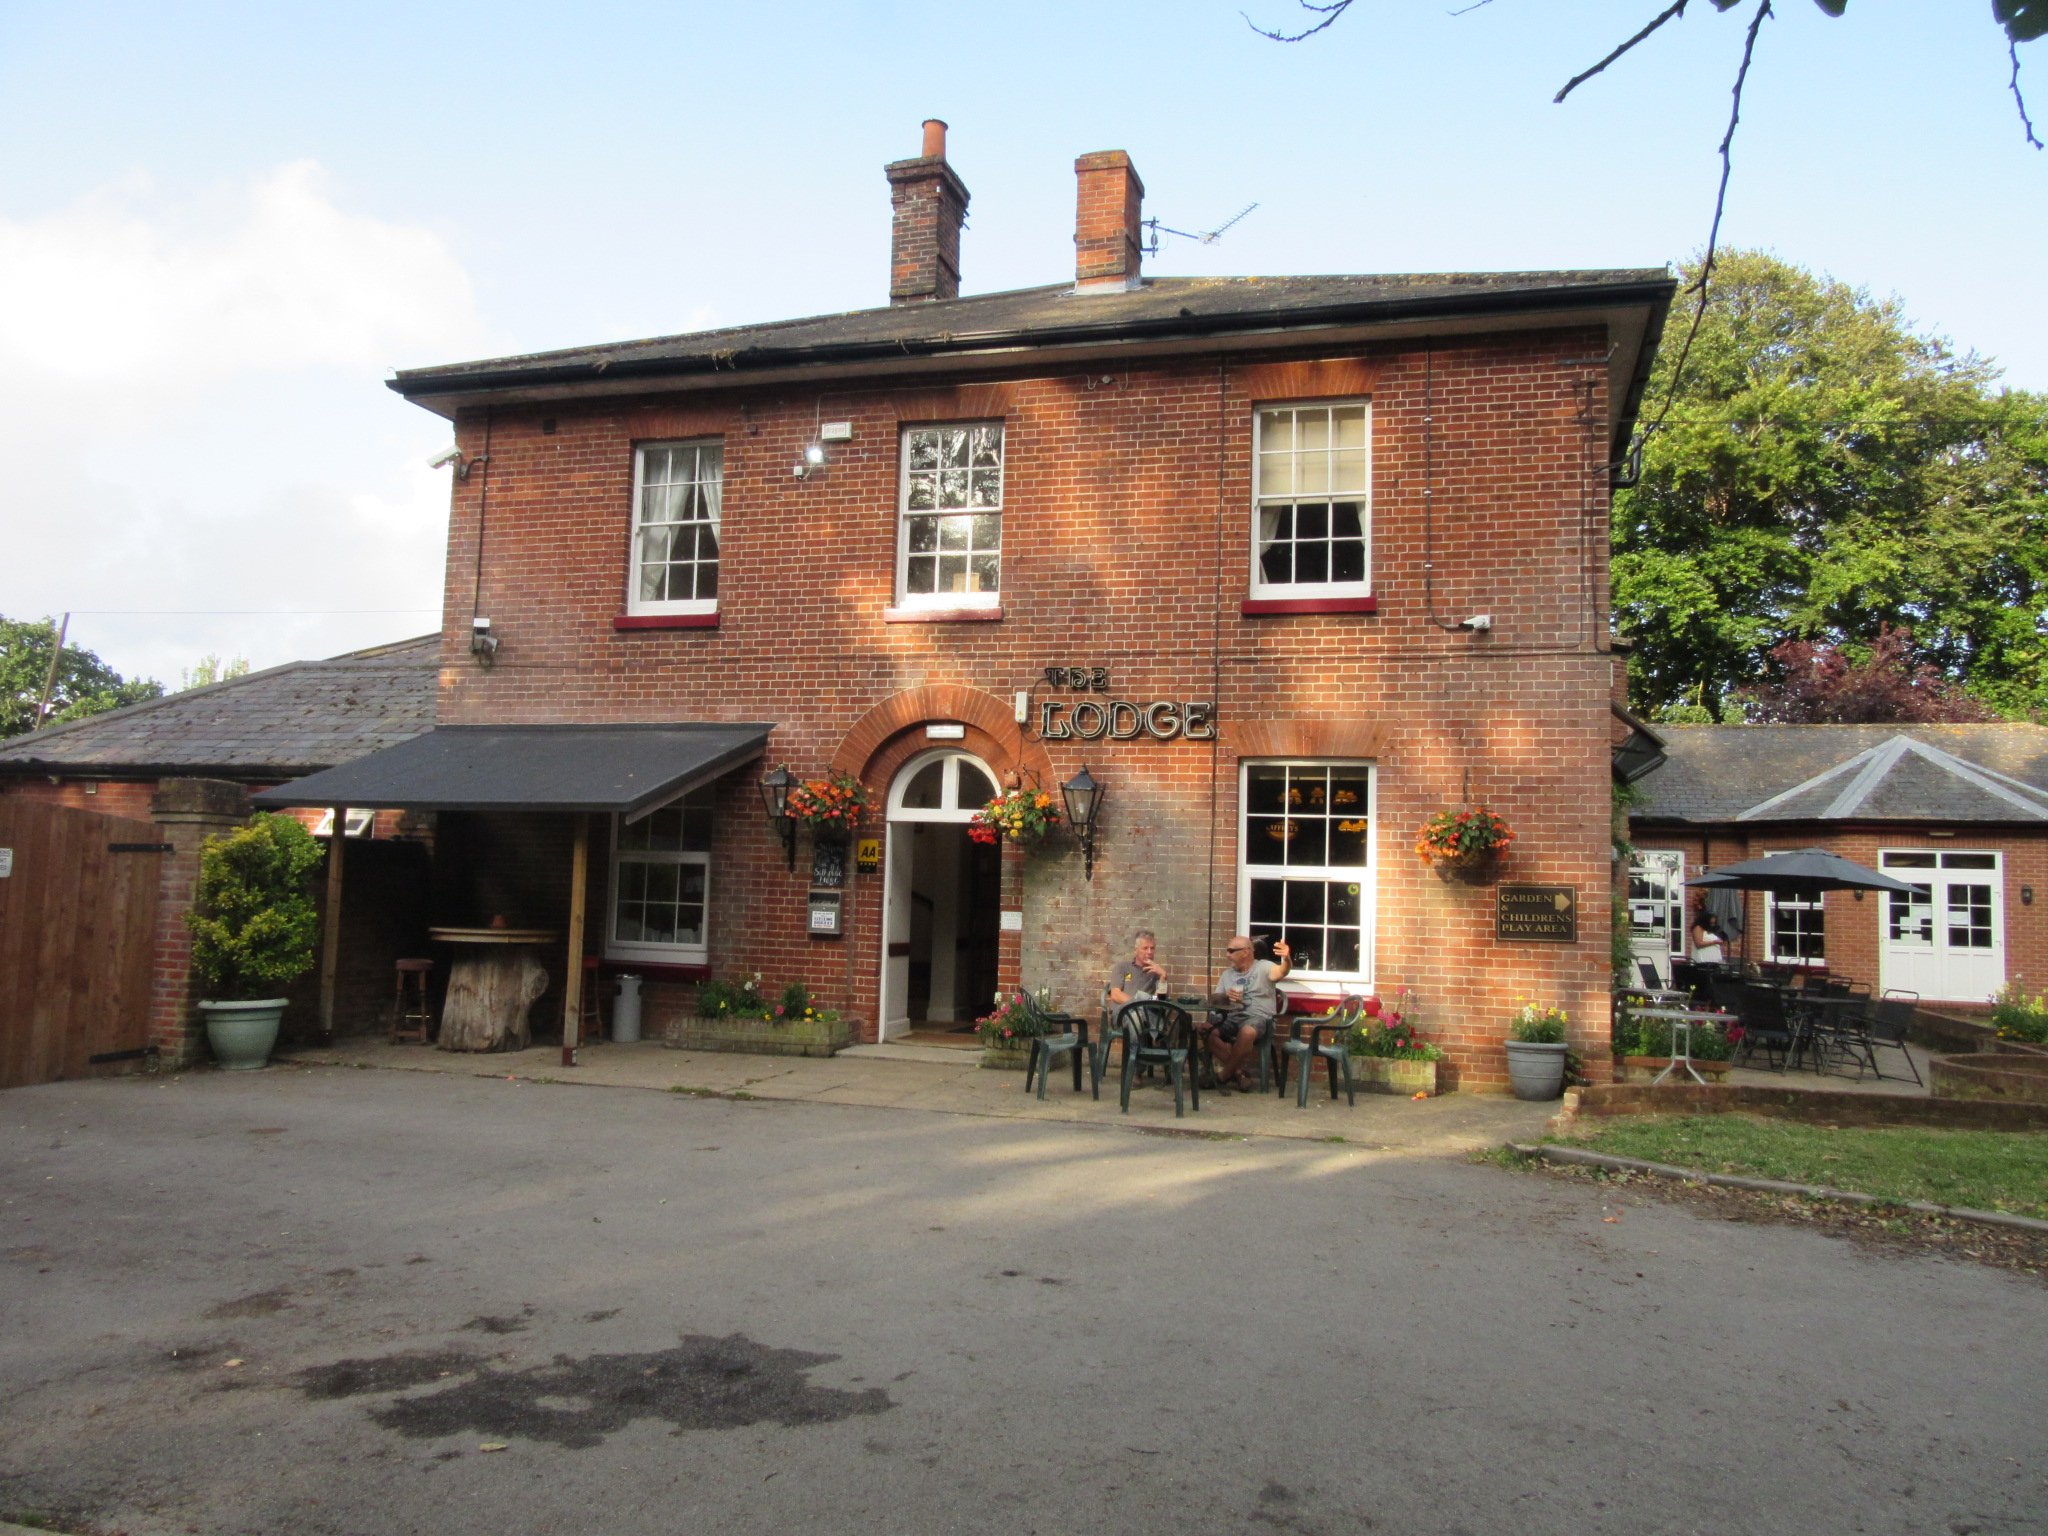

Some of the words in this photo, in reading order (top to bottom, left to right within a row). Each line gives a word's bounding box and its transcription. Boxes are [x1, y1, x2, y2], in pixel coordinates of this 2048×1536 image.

[1041, 701, 1216, 740] LODGE
[861, 846, 876, 858] AA
[1501, 894, 1552, 903] GARDEN
[1501, 914, 1572, 922] CHILDRENS
[1502, 924, 1532, 932] PLAY
